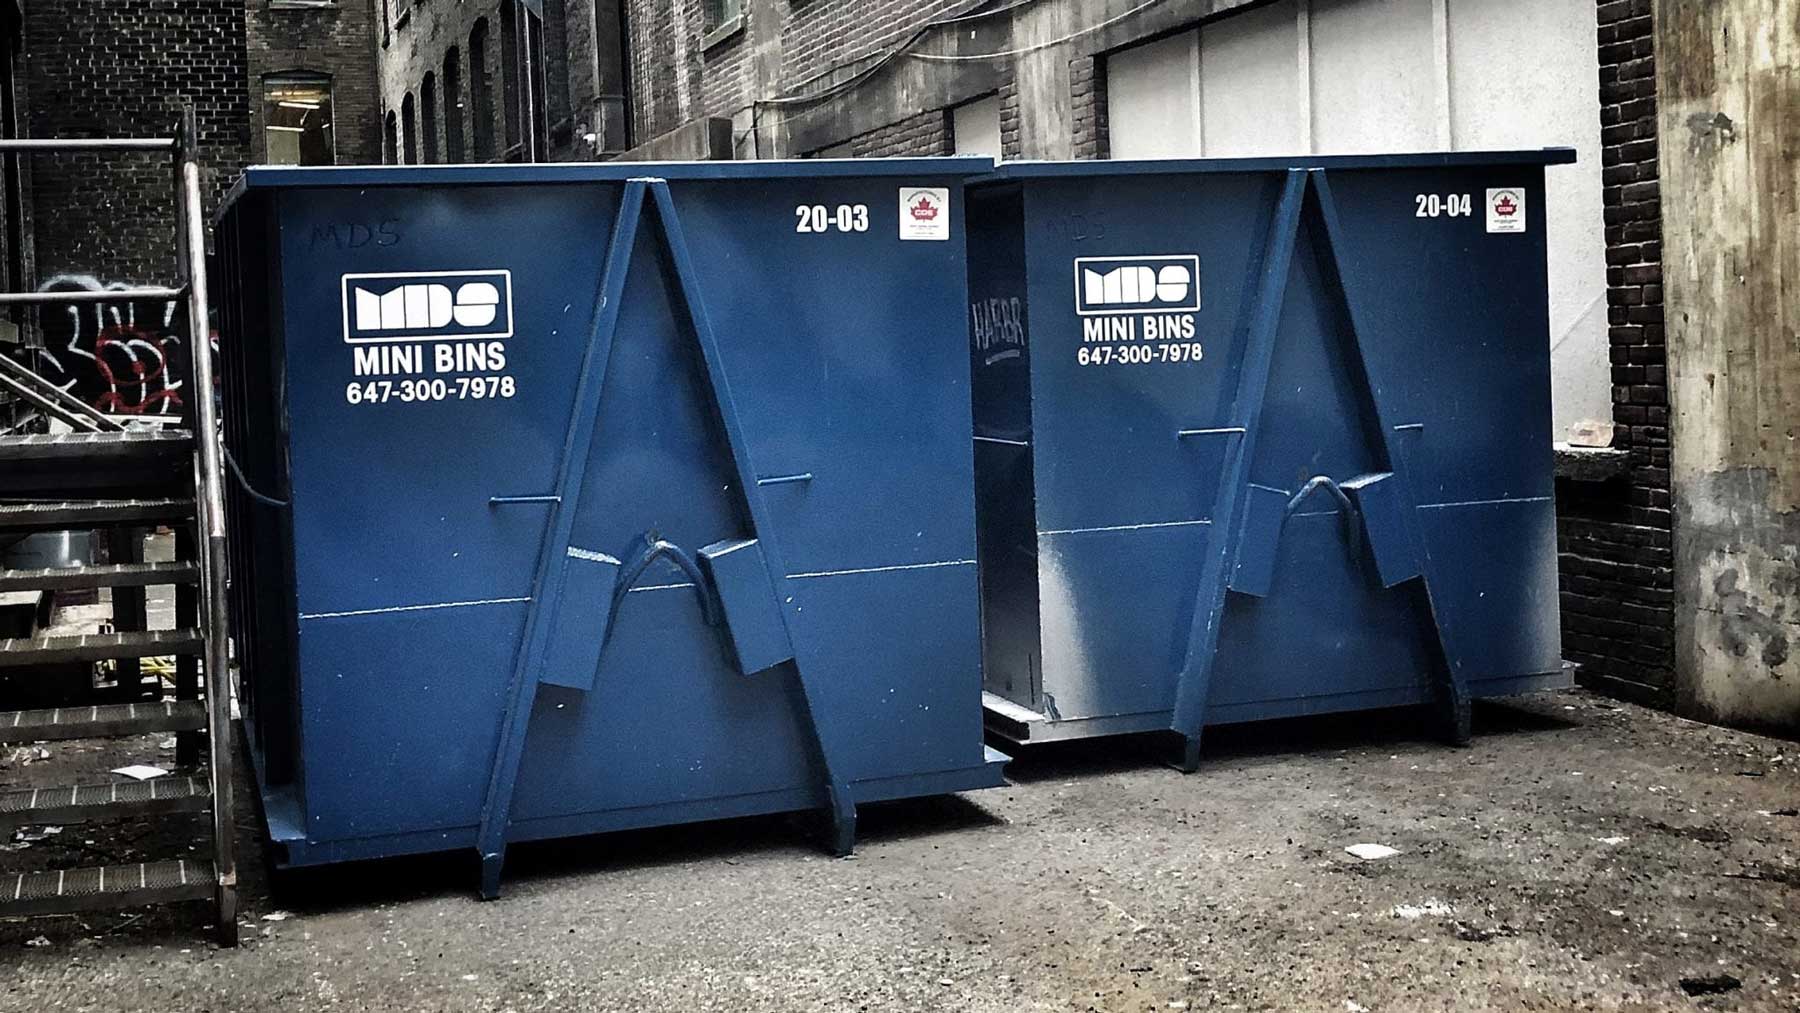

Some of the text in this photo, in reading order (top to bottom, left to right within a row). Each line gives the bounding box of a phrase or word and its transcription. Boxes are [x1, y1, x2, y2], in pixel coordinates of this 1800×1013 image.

[795, 204, 869, 233] 20-03
[1415, 194, 1472, 218] 20-04
[1084, 264, 1191, 305] MDS
[354, 281, 500, 331] MDS
[1083, 313, 1195, 342] MINI BINS
[353, 341, 506, 377] MINI BINS
[1077, 342, 1203, 366] 647-300-7978
[346, 375, 516, 405] 647-300-7978
